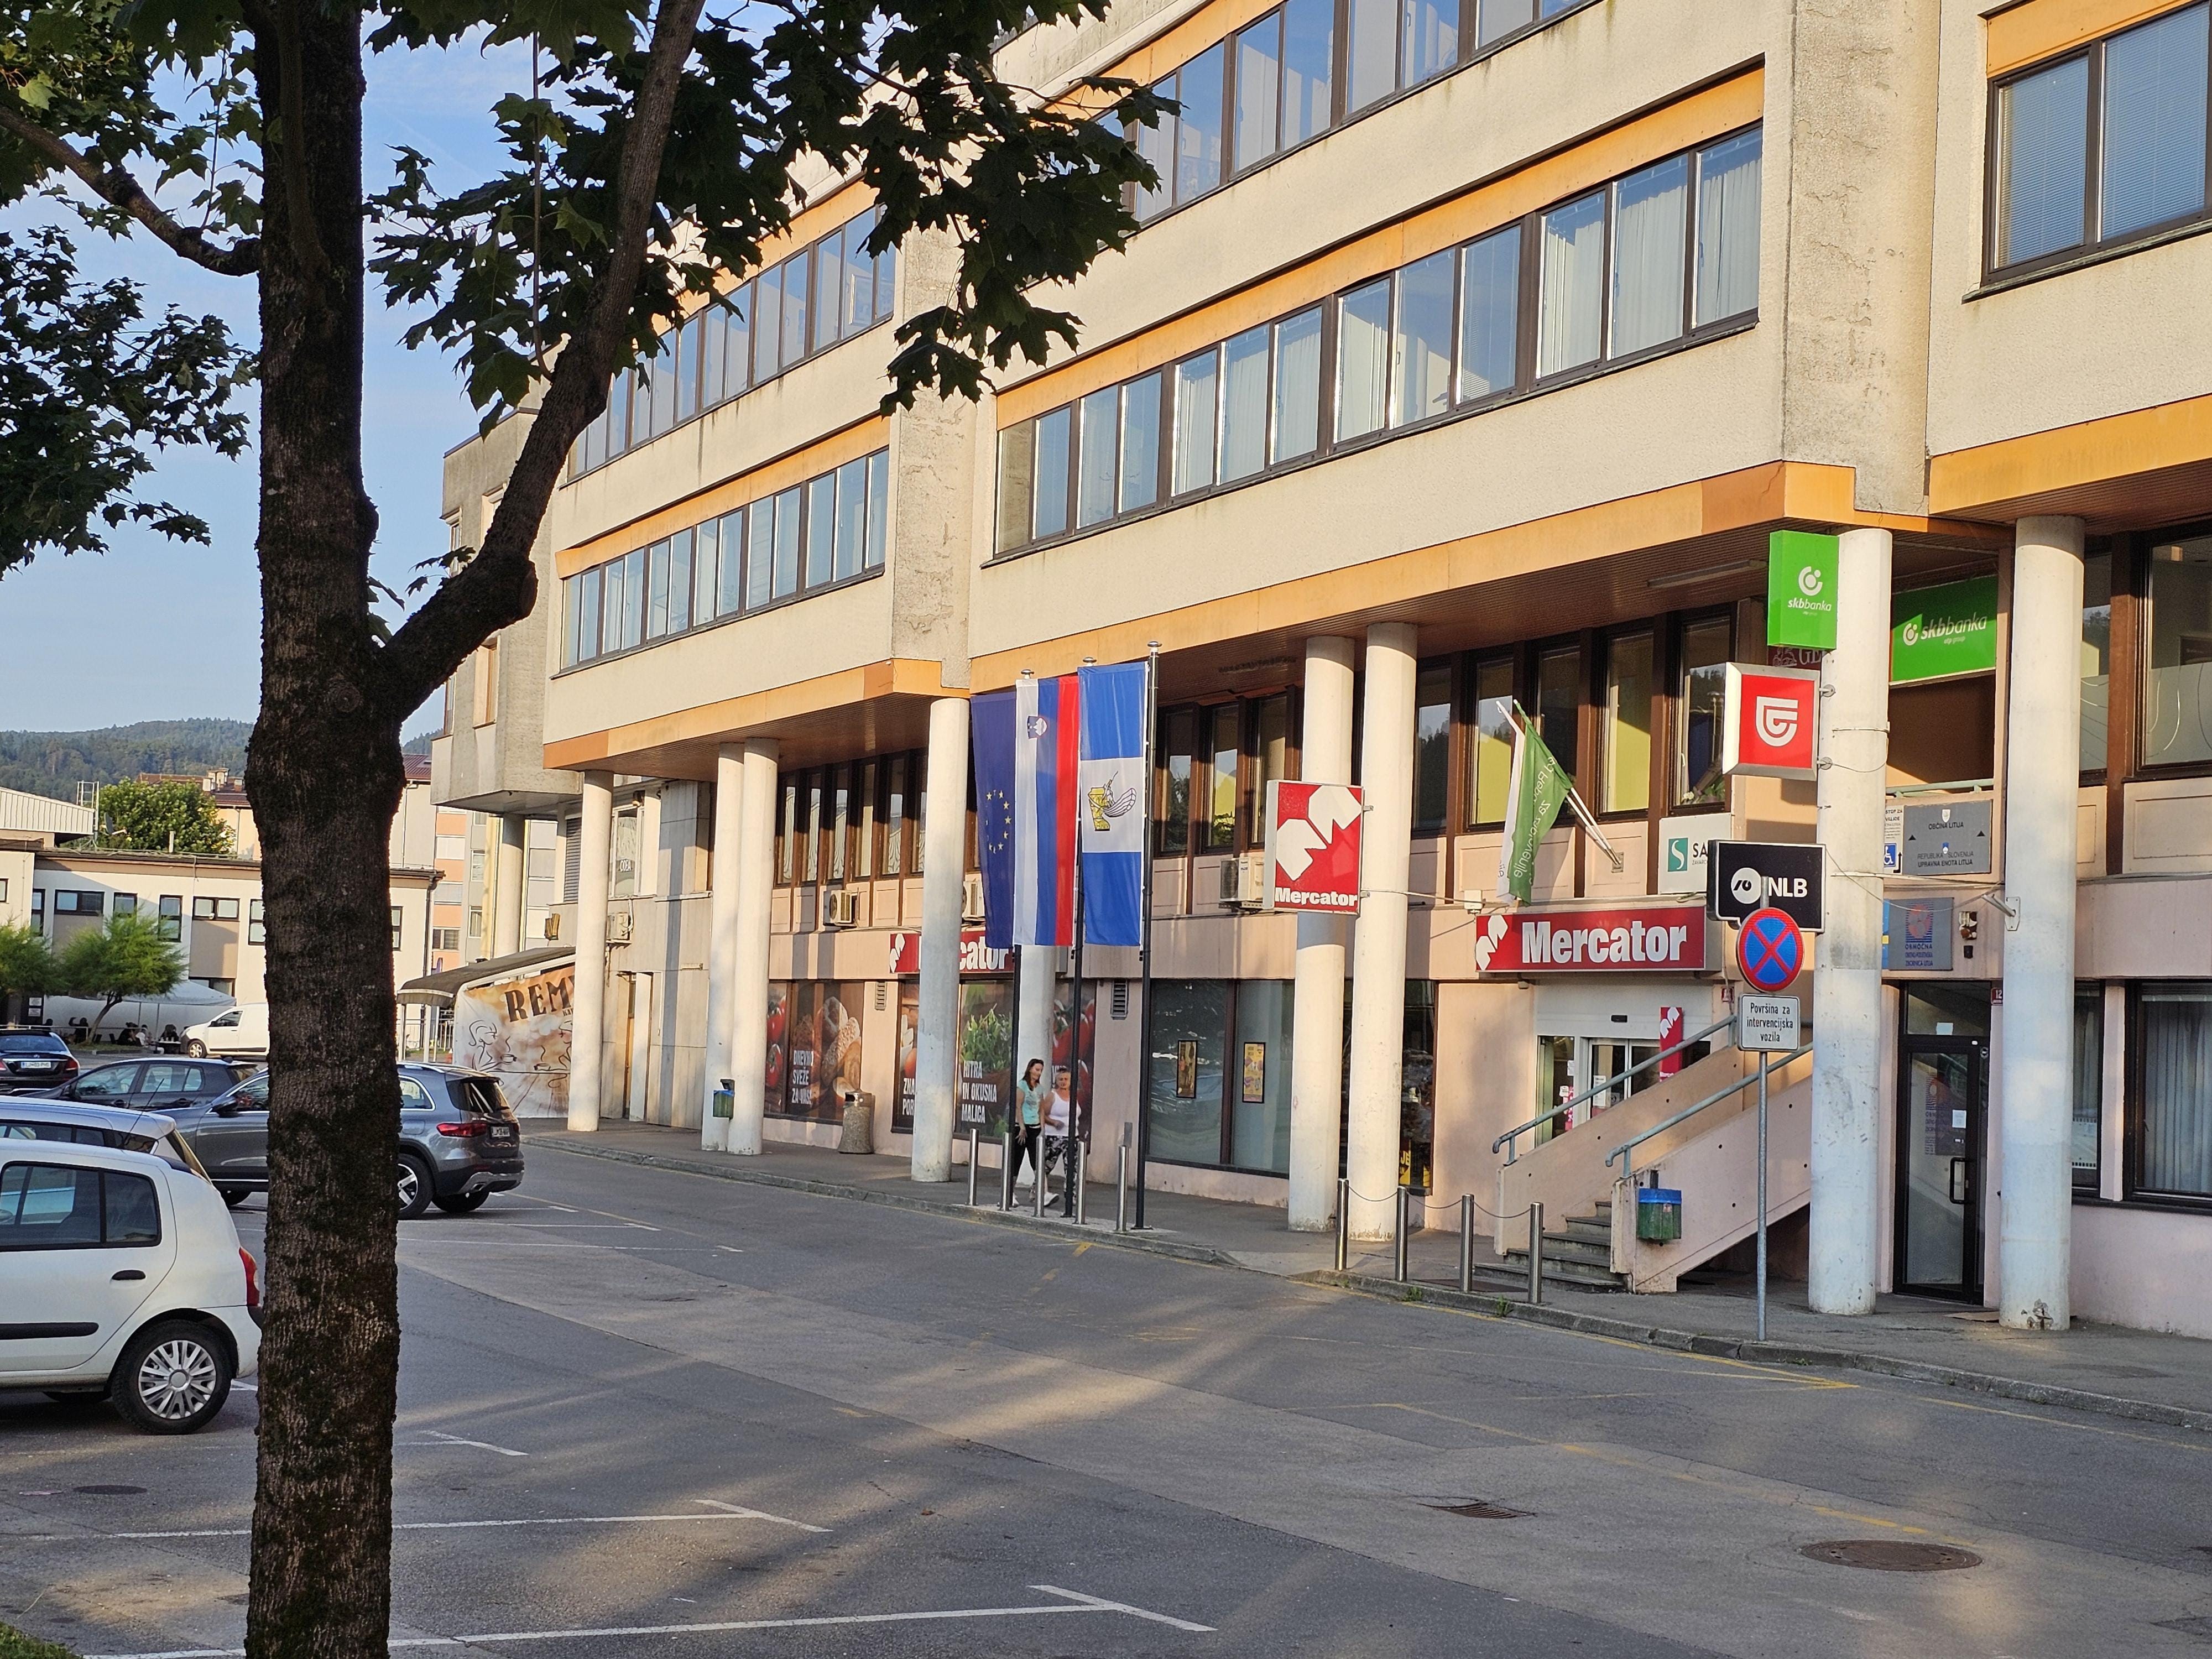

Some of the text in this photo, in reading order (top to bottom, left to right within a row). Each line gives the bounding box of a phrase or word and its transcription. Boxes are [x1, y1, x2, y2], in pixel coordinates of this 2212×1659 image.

[1787, 598, 1832, 612] skbbanka
[1921, 612, 1987, 640] skbbanka
[1275, 887, 1358, 906] Mercator
[1768, 877, 1808, 898] NLB
[1522, 921, 1687, 963] Mercator
[1750, 1003, 1778, 1014] Površina
[1747, 1016, 1793, 1031] intervencijska
[1760, 1032, 1780, 1042] vozila
[963, 1060, 983, 1078] HITRA
[962, 1082, 997, 1103] IN OKUSNA
[962, 1104, 986, 1124] MALICA
